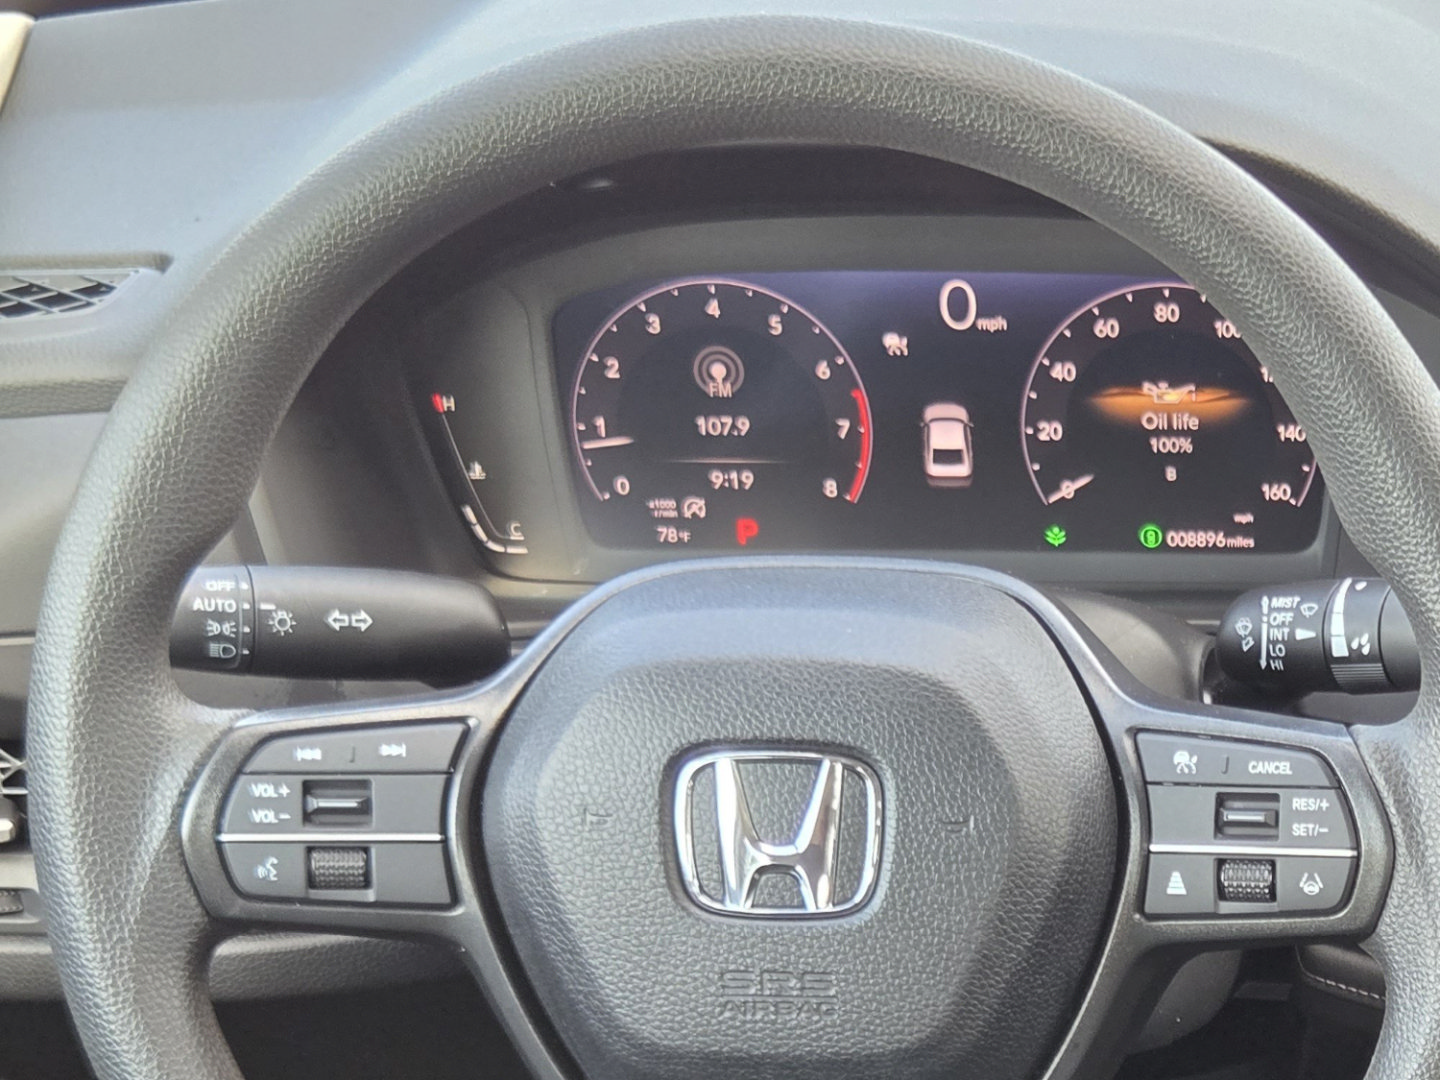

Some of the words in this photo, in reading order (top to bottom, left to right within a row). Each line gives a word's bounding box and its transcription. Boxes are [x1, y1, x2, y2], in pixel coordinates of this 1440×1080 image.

[705, 299, 720, 318] 4
[939, 279, 977, 330] 0
[977, 316, 1007, 333] mph
[1153, 303, 1180, 323] 80
[645, 314, 661, 334] 3
[767, 314, 783, 335] 5
[1093, 319, 1119, 339] 60
[604, 358, 620, 378] 2
[815, 360, 831, 379] 6
[1050, 363, 1077, 383] 40
[709, 383, 732, 398] FM
[442, 396, 455, 412] H
[594, 416, 606, 437] 1
[696, 416, 750, 436] 107.9
[836, 419, 850, 439] 7
[1141, 412, 1168, 431] Oil
[1172, 412, 1199, 431] life
[1037, 422, 1063, 442] 20
[1150, 437, 1193, 454] 100%
[614, 476, 630, 495] 0
[709, 470, 754, 490] 9:19
[823, 478, 838, 498] 8
[1261, 483, 1292, 502] 160
[736, 517, 759, 545] P
[1166, 531, 1225, 548] 008896
[205, 581, 236, 592] OFF
[193, 597, 237, 613] AUTO
[1270, 597, 1301, 609] MIST
[1269, 612, 1294, 626] OFF
[1269, 628, 1290, 641] INT
[1269, 644, 1286, 657] LO
[1269, 660, 1284, 671] HI
[1248, 761, 1292, 775] CANCEL
